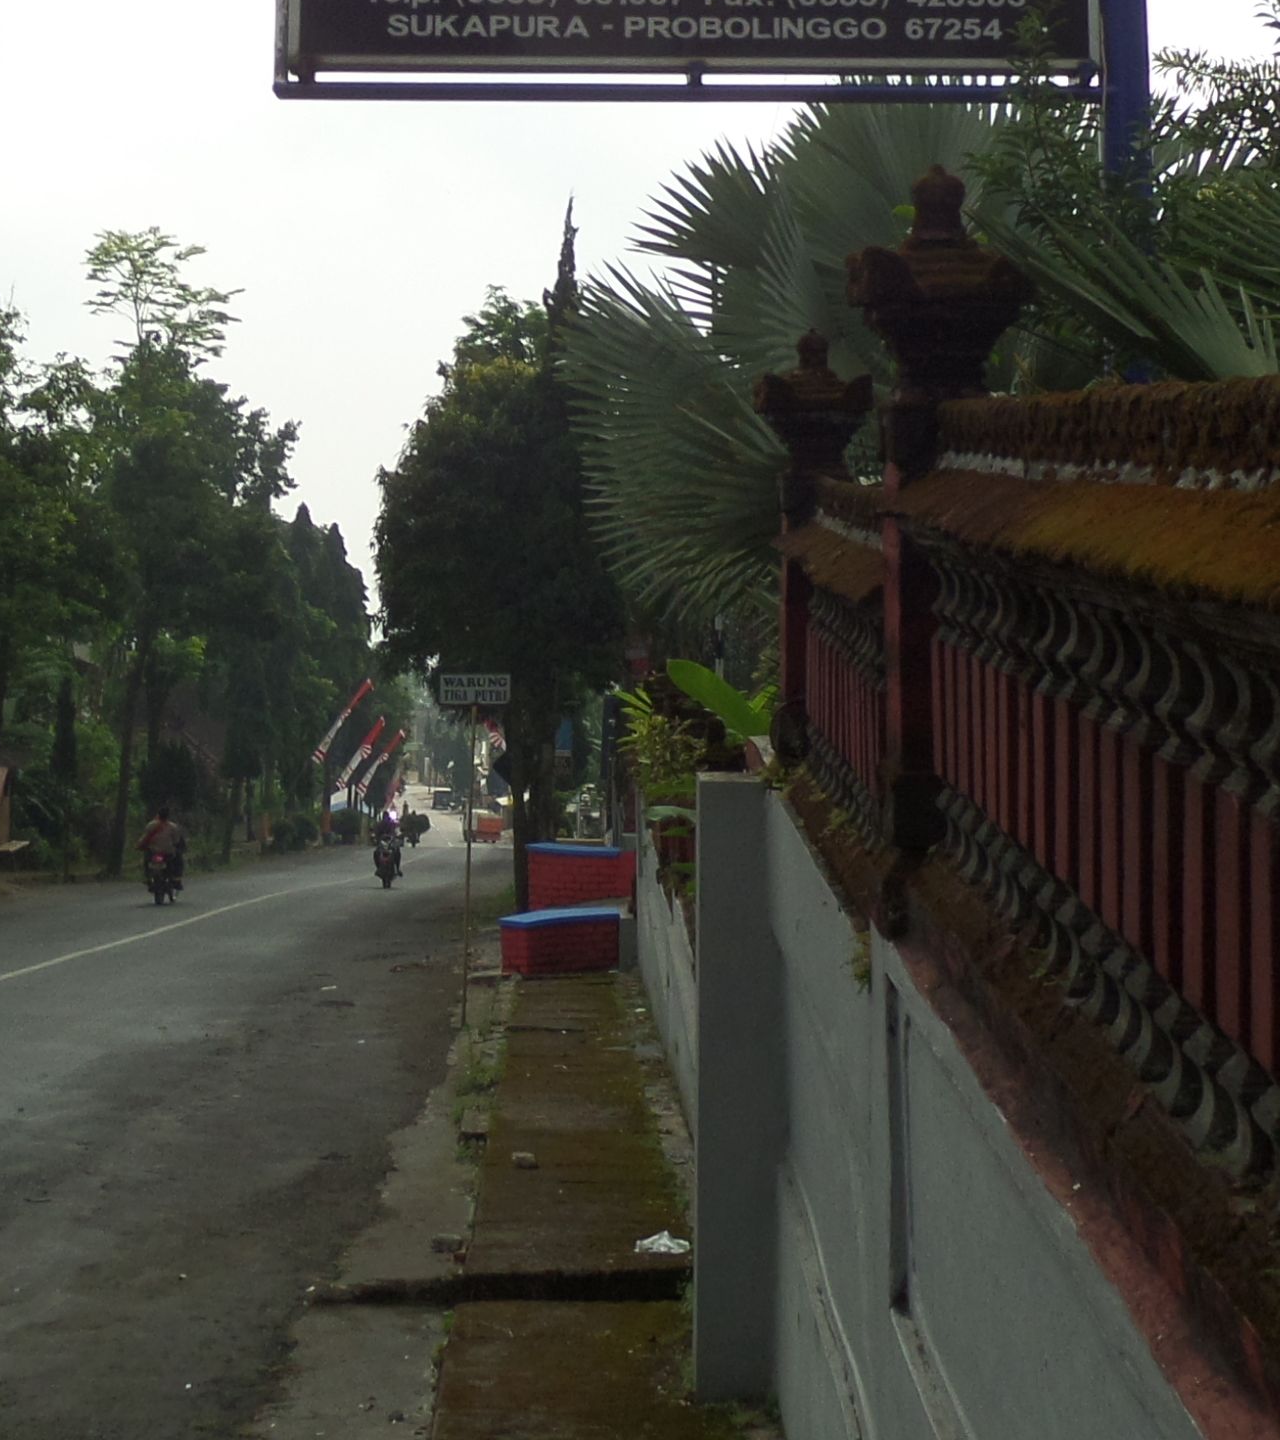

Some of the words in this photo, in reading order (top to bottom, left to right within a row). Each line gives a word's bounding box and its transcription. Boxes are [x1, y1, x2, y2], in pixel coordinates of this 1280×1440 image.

[387, 15, 589, 39] SUKAPURA
[624, 15, 886, 41] PROBOLINGGO
[905, 17, 1003, 41] 67254
[443, 677, 507, 687] WARUNG
[444, 689, 468, 701] TIGA
[475, 689, 507, 701] PUTRI
